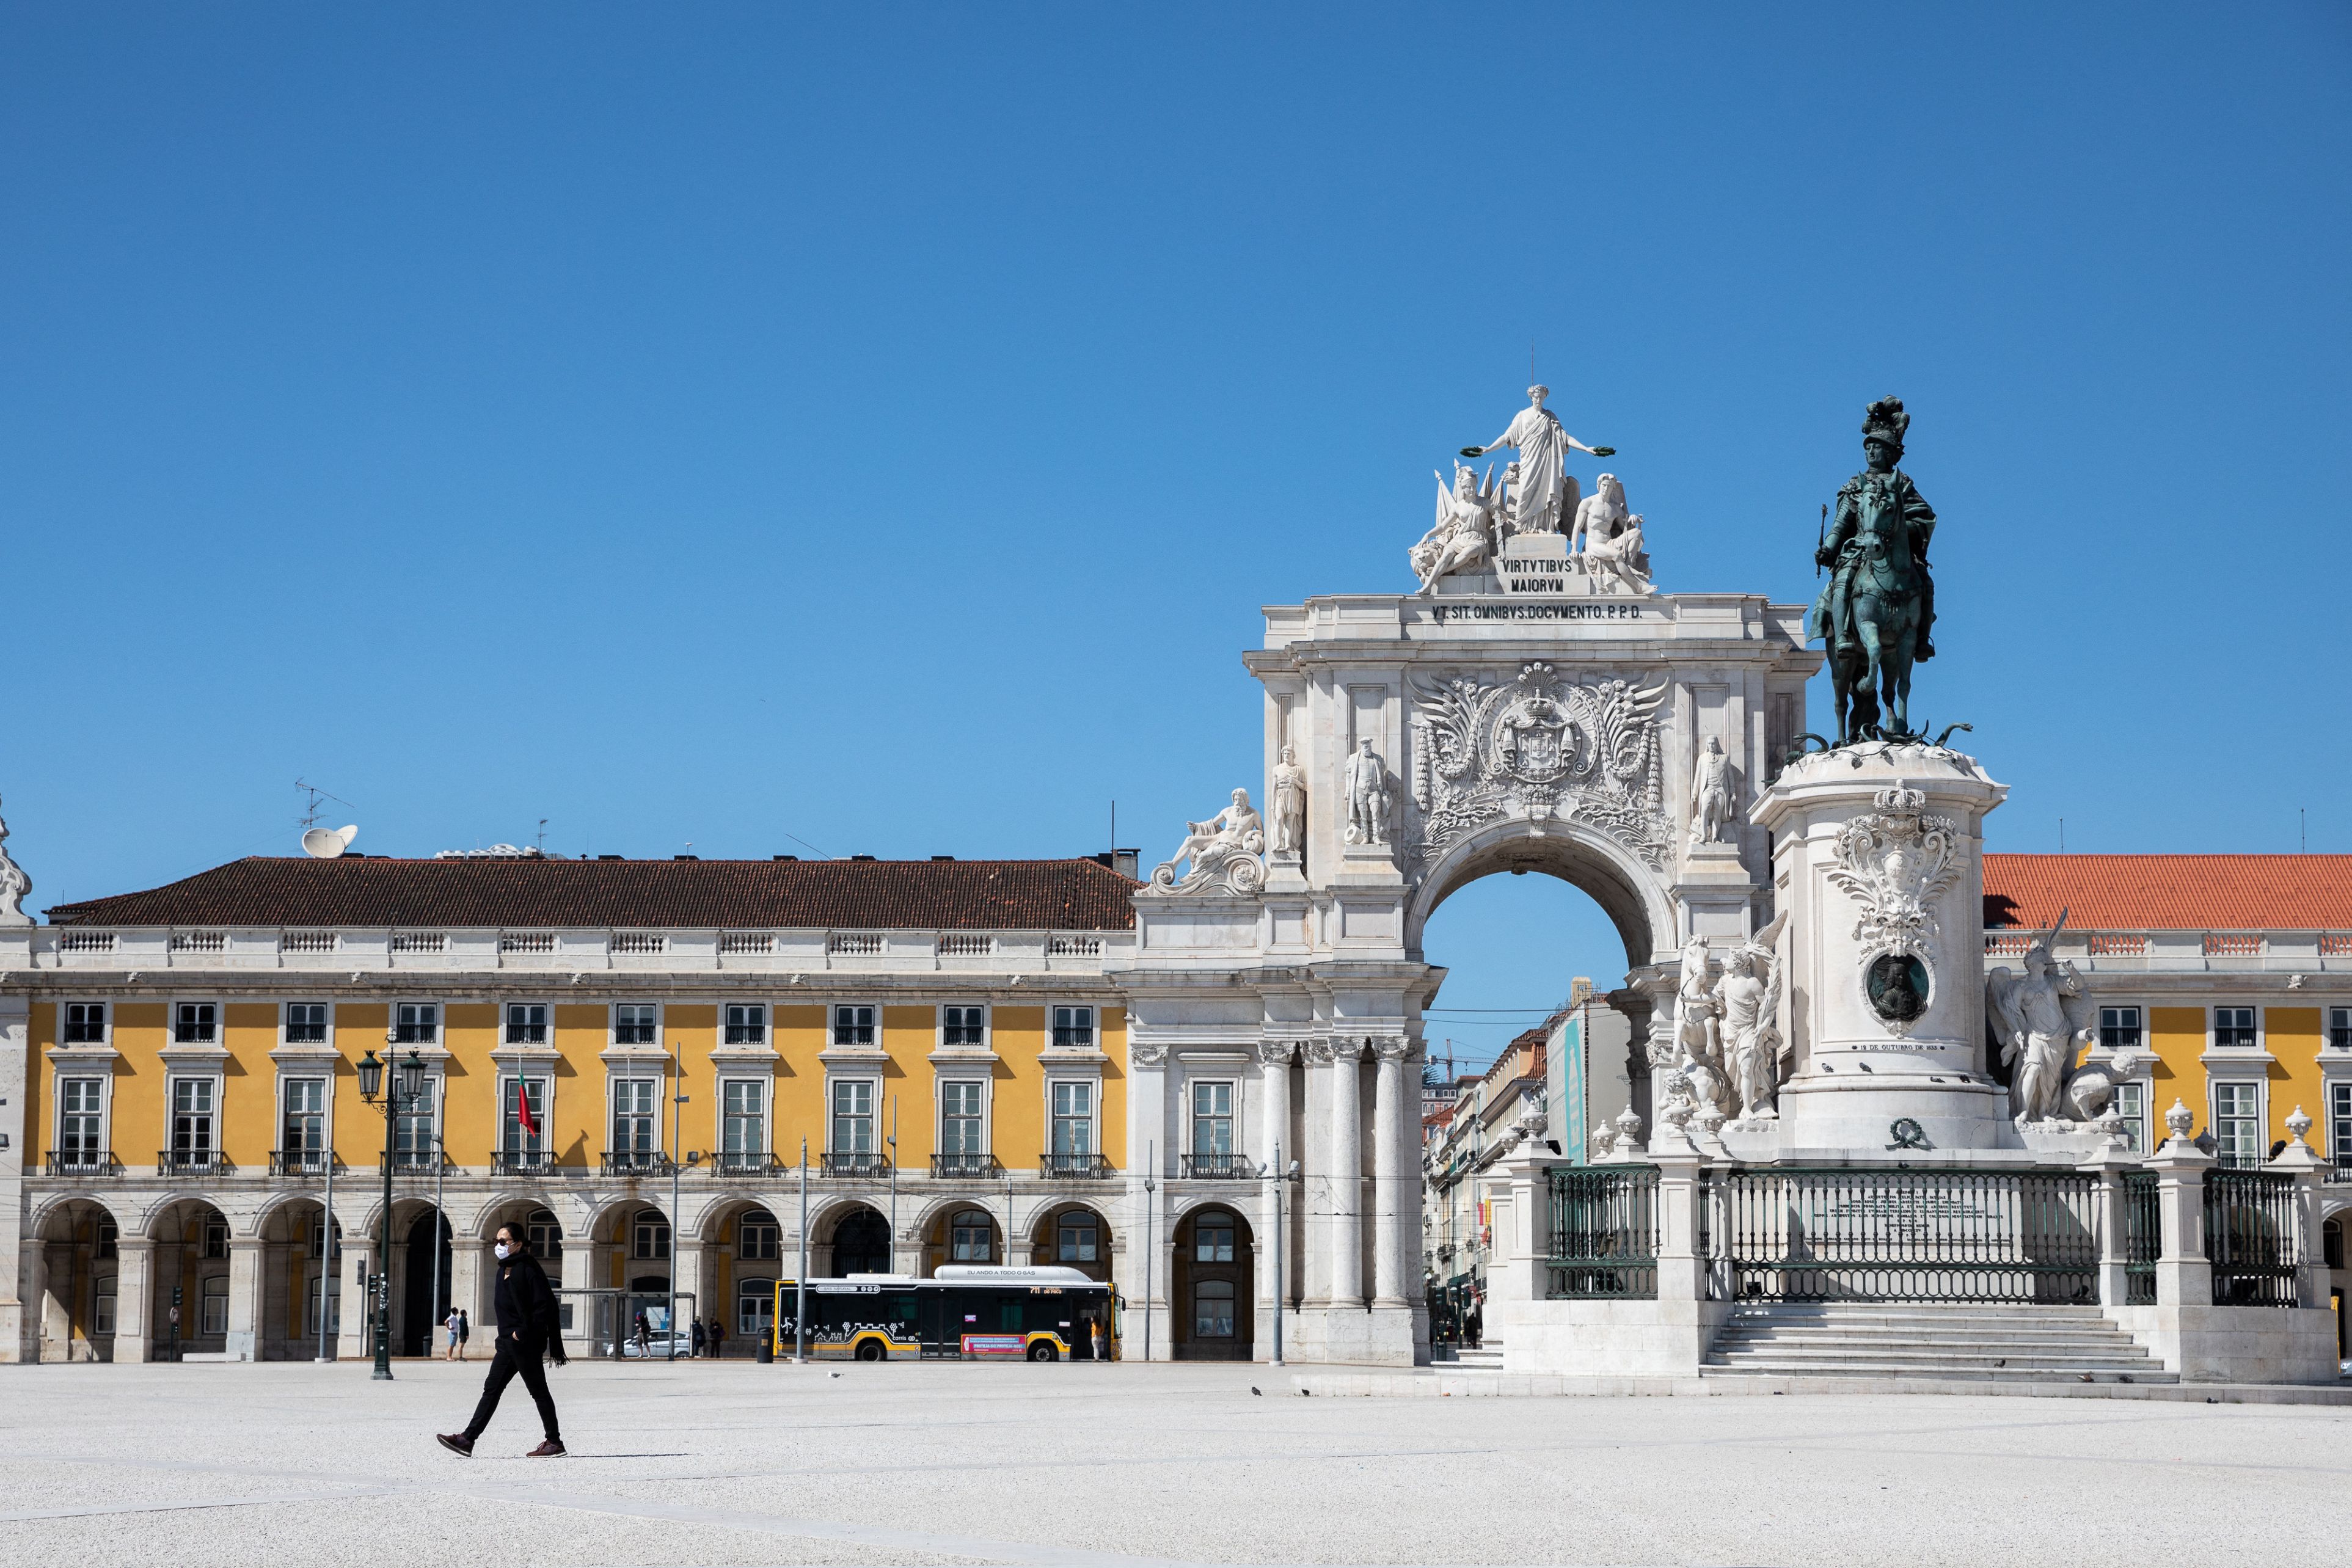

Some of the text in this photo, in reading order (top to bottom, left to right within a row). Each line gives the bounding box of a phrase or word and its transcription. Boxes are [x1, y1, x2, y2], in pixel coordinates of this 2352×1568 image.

[1502, 559, 1572, 573] VIRTVTIBVS
[1511, 578, 1564, 593] MAIORVM
[1452, 605, 1471, 619] SIT.
